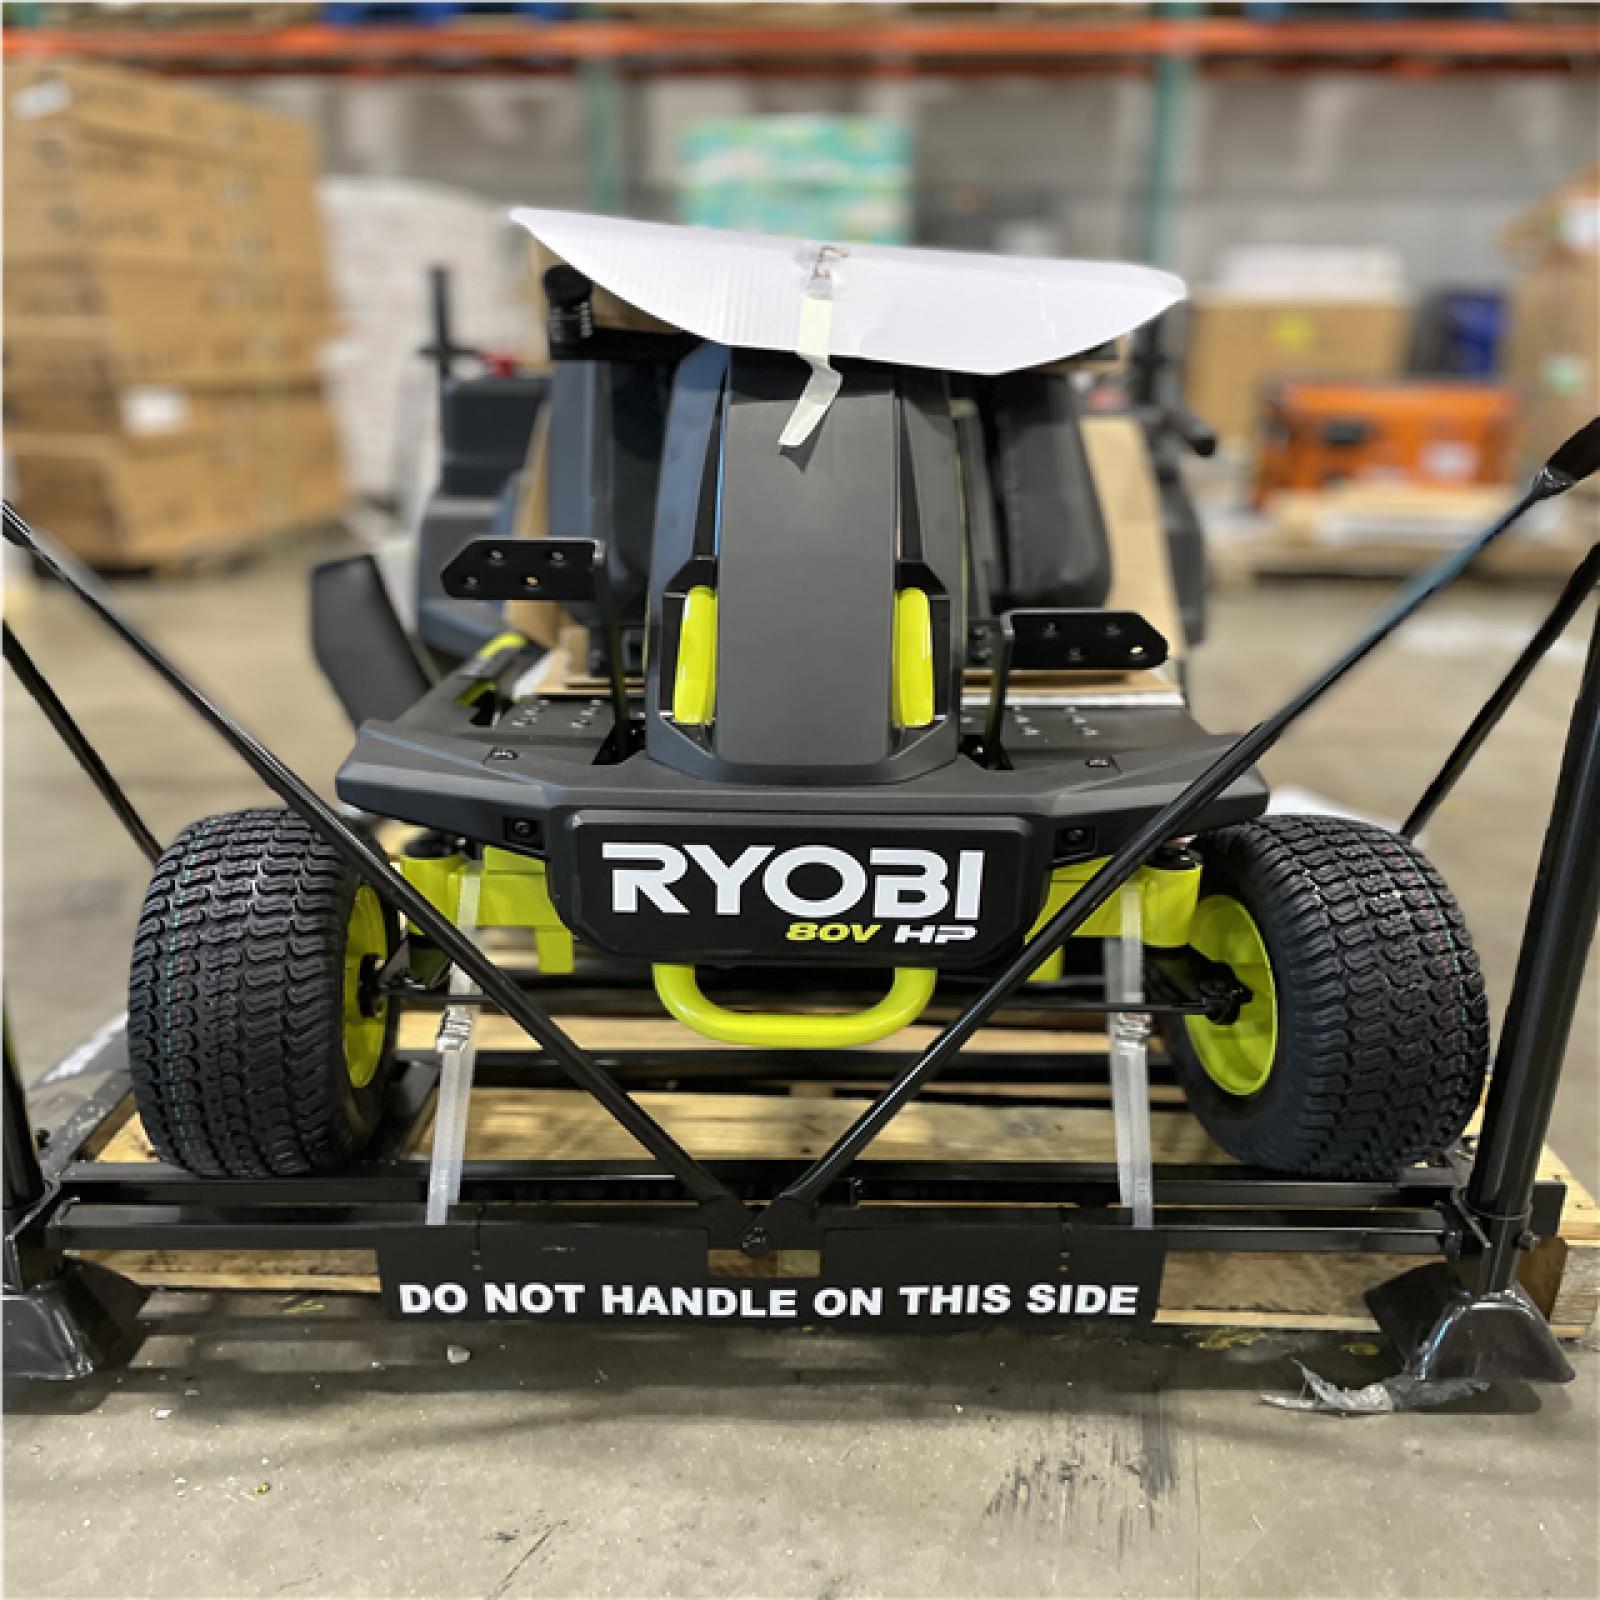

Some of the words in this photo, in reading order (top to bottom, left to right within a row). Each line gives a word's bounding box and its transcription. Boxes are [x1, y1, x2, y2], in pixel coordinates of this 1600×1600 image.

[602, 843, 984, 920] RYOBI
[787, 923, 881, 942] 80V
[895, 925, 977, 943] HP
[400, 1283, 467, 1313] DO
[485, 1283, 585, 1313] NOT
[602, 1285, 797, 1316] HANDLE
[815, 1288, 882, 1315] ON
[900, 1285, 1010, 1315] THIS
[1027, 1285, 1138, 1315] SIDE
